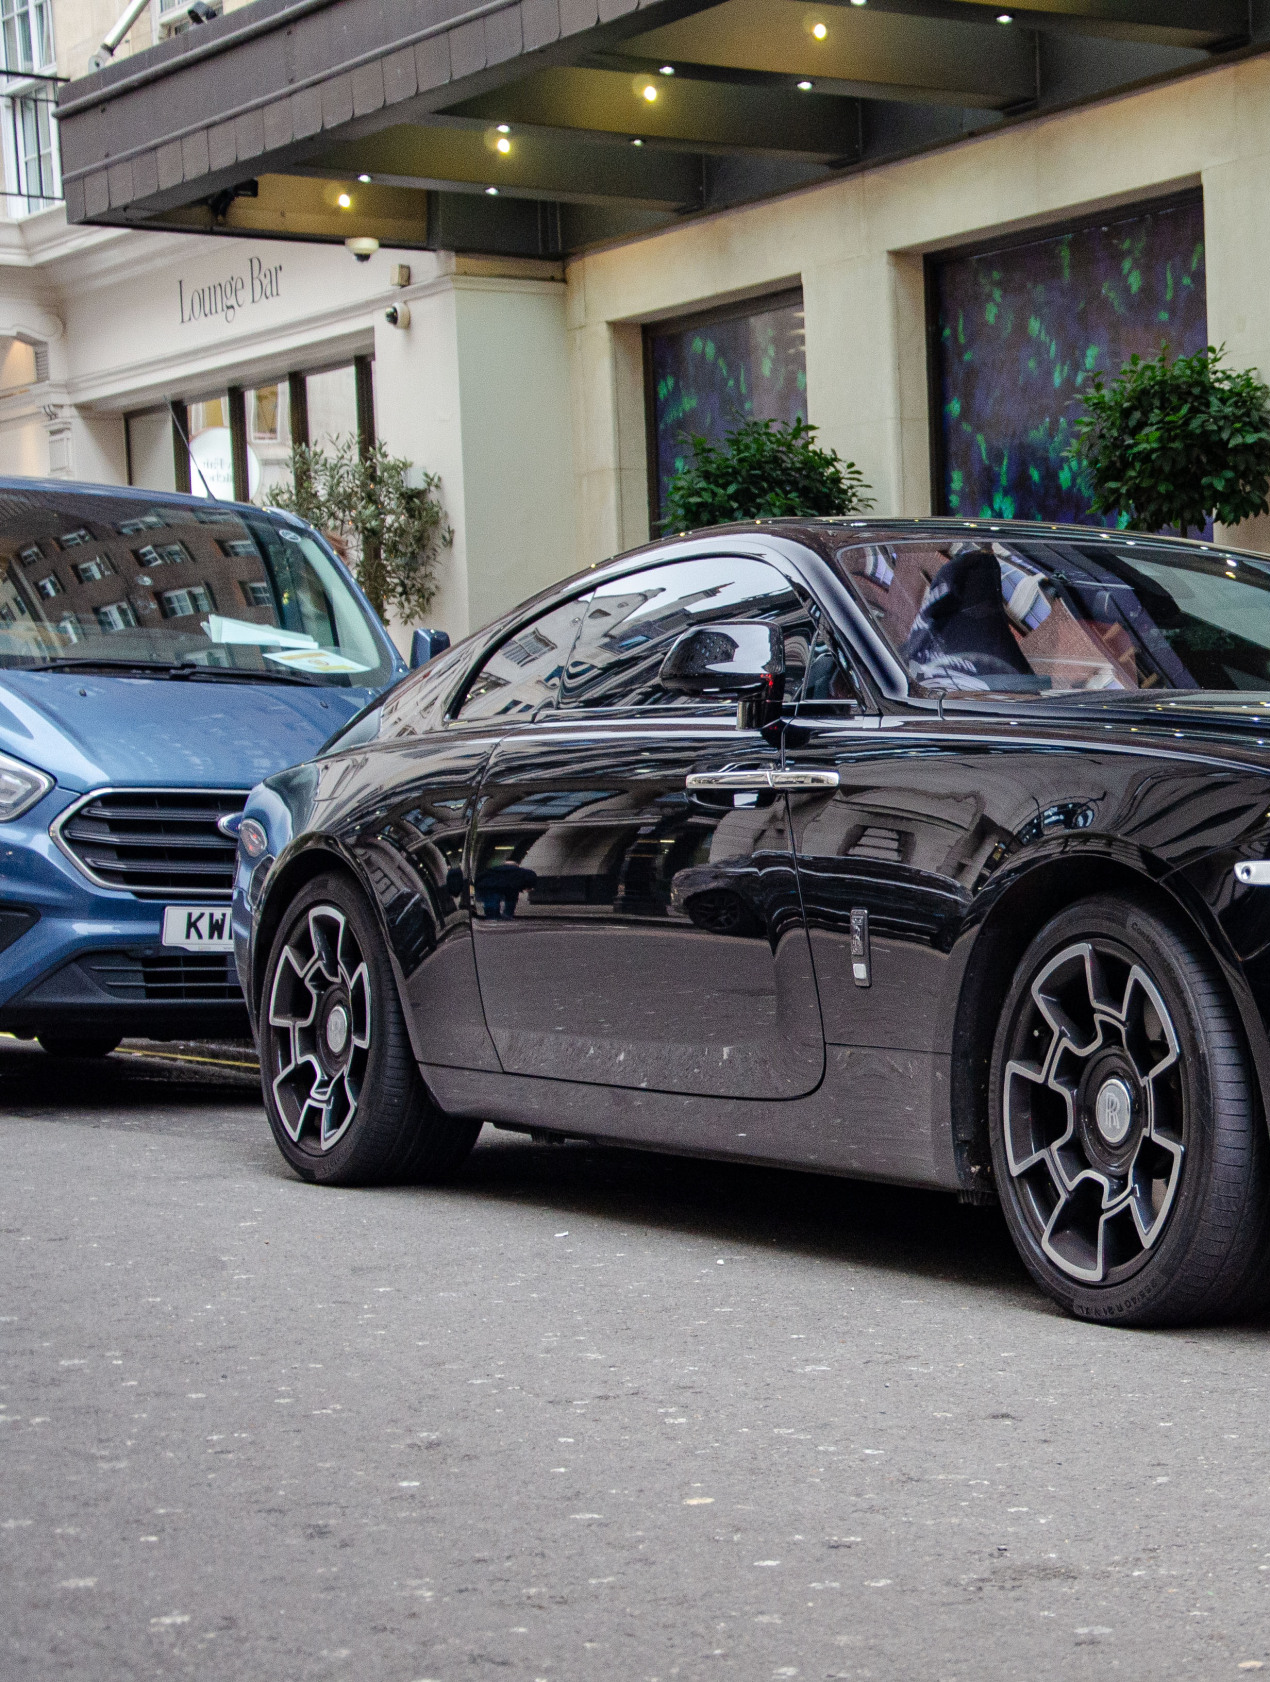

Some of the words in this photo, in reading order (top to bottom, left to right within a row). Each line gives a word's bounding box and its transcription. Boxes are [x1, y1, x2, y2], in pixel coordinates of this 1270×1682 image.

[178, 276, 245, 324] Lounge
[248, 256, 283, 304] Bar
[184, 911, 234, 940] KW
